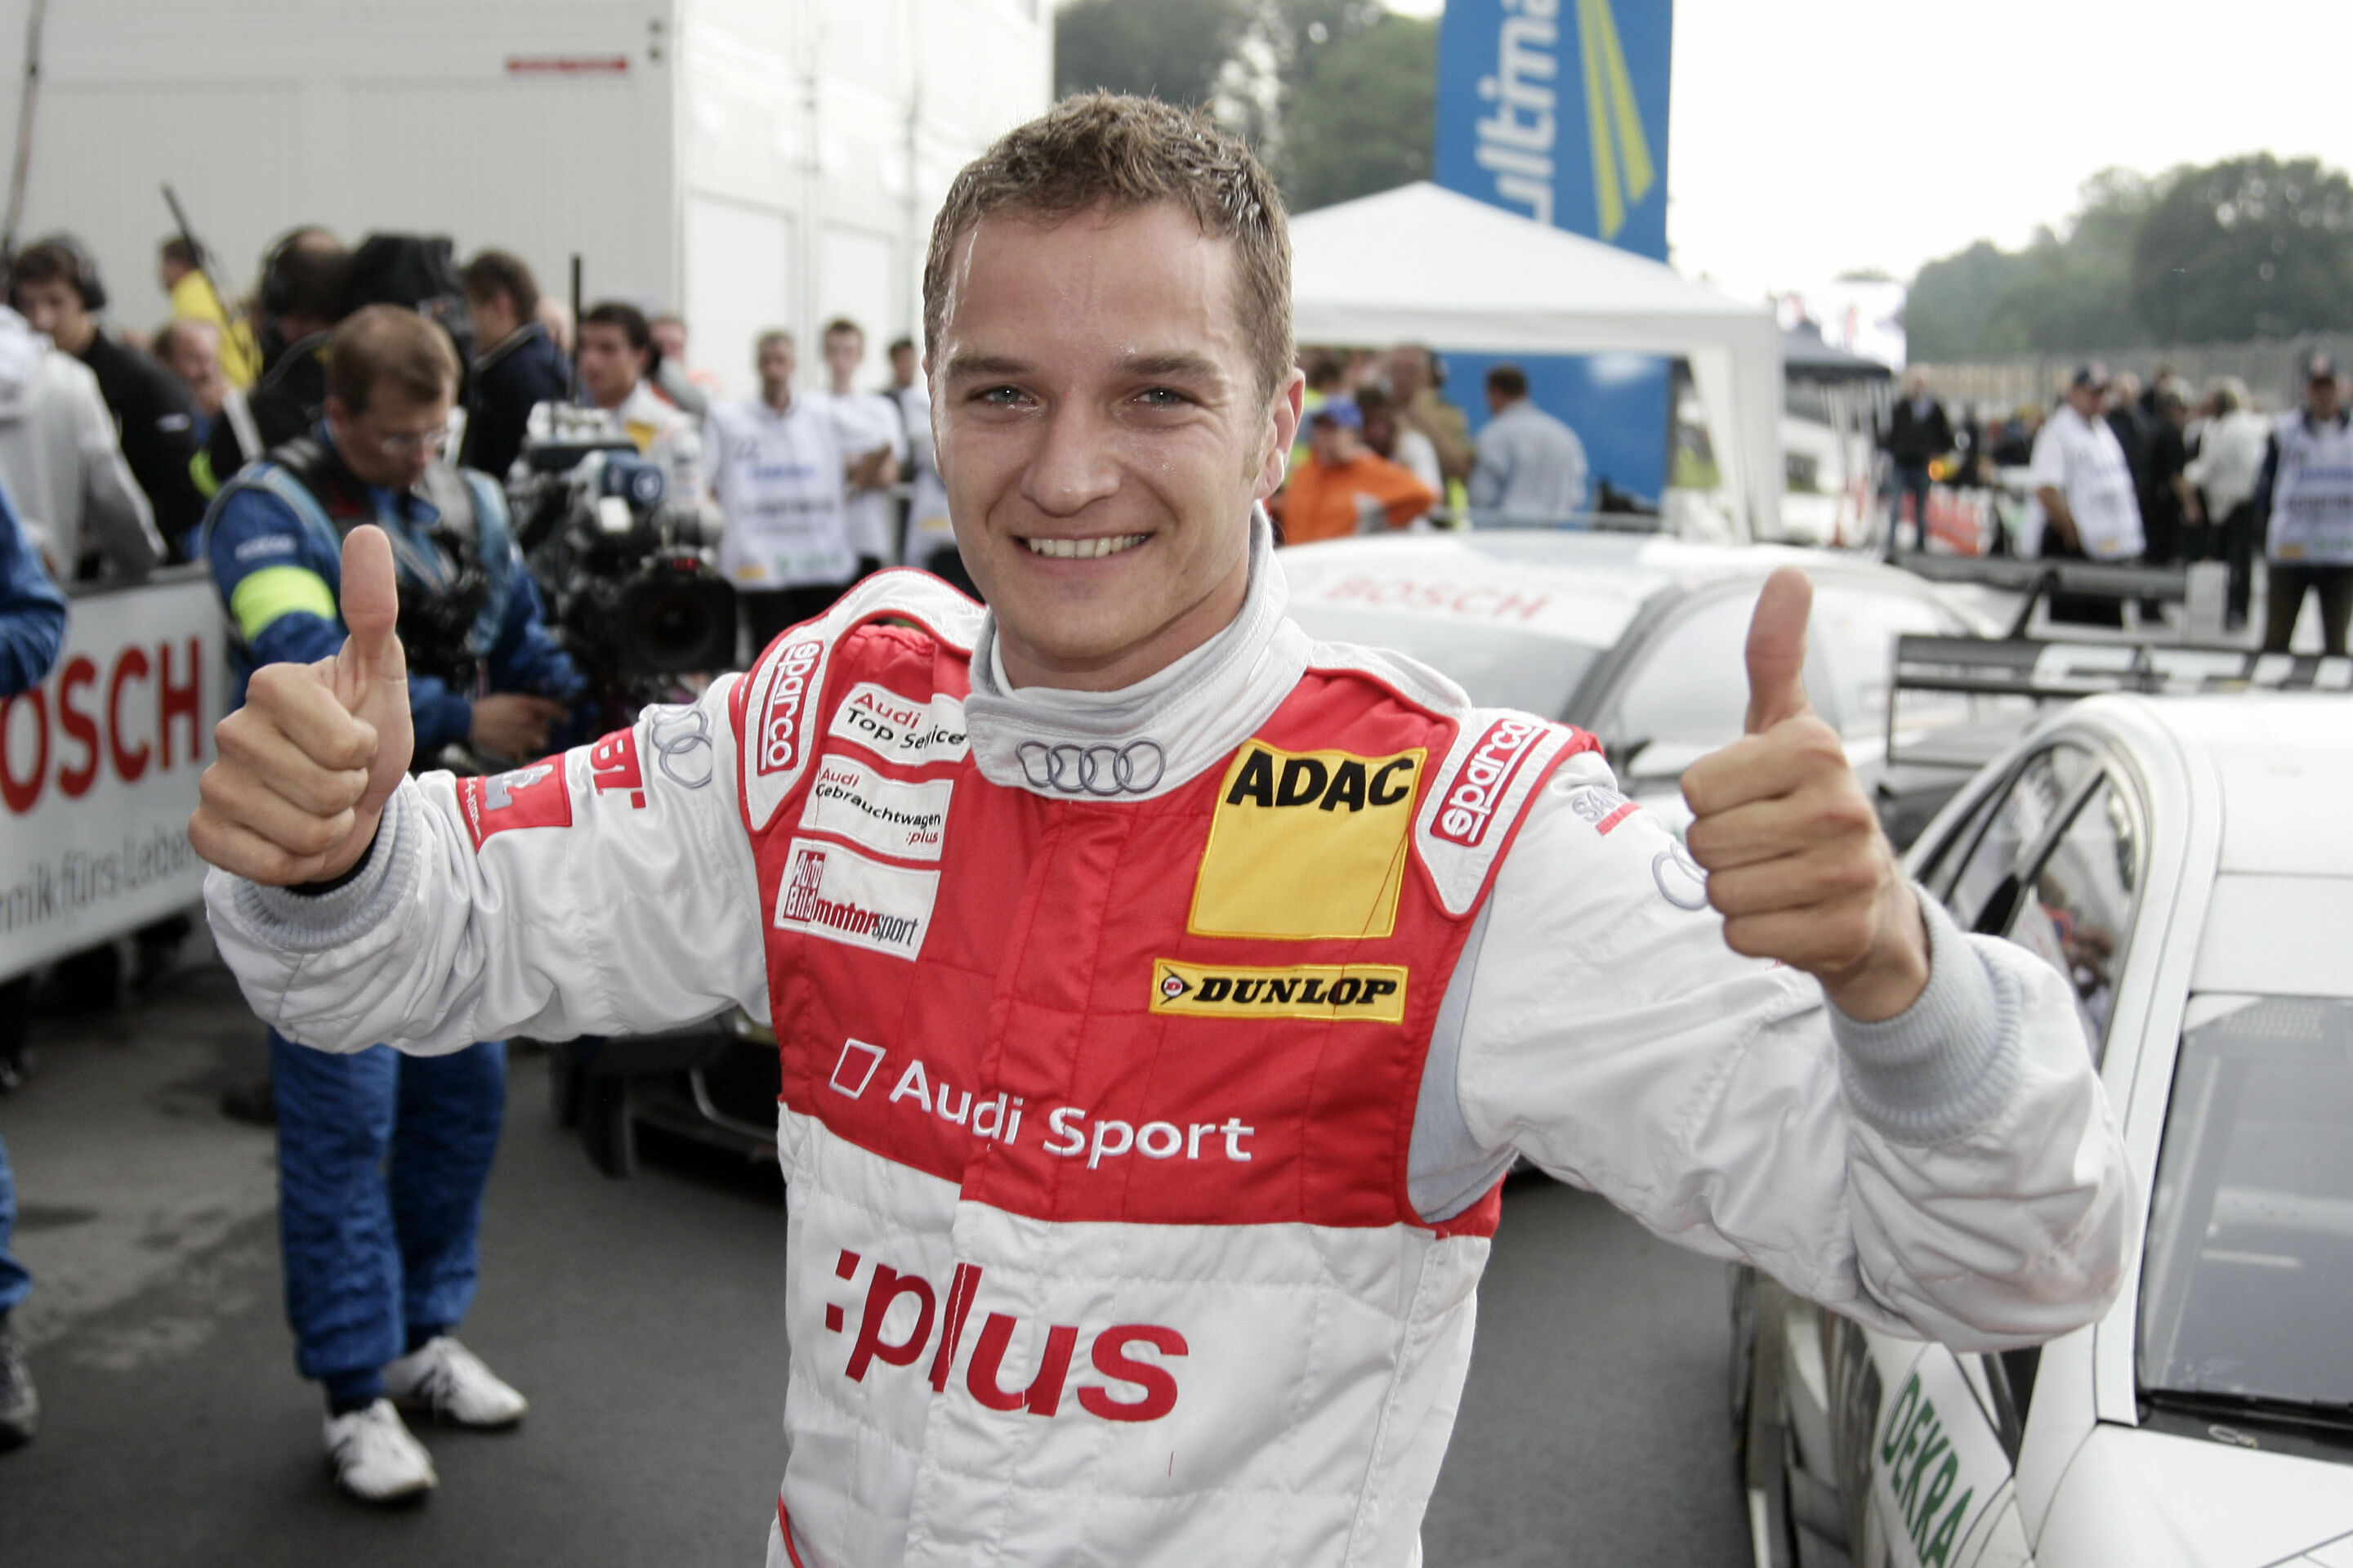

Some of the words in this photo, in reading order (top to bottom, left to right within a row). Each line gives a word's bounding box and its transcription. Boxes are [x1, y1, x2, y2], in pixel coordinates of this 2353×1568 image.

[1325, 577, 1547, 619] BOSCH
[765, 642, 820, 768] sparco
[847, 707, 894, 742] Top
[855, 692, 922, 730] Audi
[820, 768, 859, 788] Audi
[1226, 750, 1415, 812] ADAC
[1441, 719, 1534, 839] sparco
[815, 783, 940, 829] Gebrauchtwagen
[795, 852, 824, 888] Auto
[787, 887, 815, 918] Bild
[1193, 977, 1397, 1005] DUNLOP
[889, 1060, 1024, 1146] Audi
[1043, 1106, 1255, 1170] Sport
[1882, 1371, 1974, 1568] DEKRA
